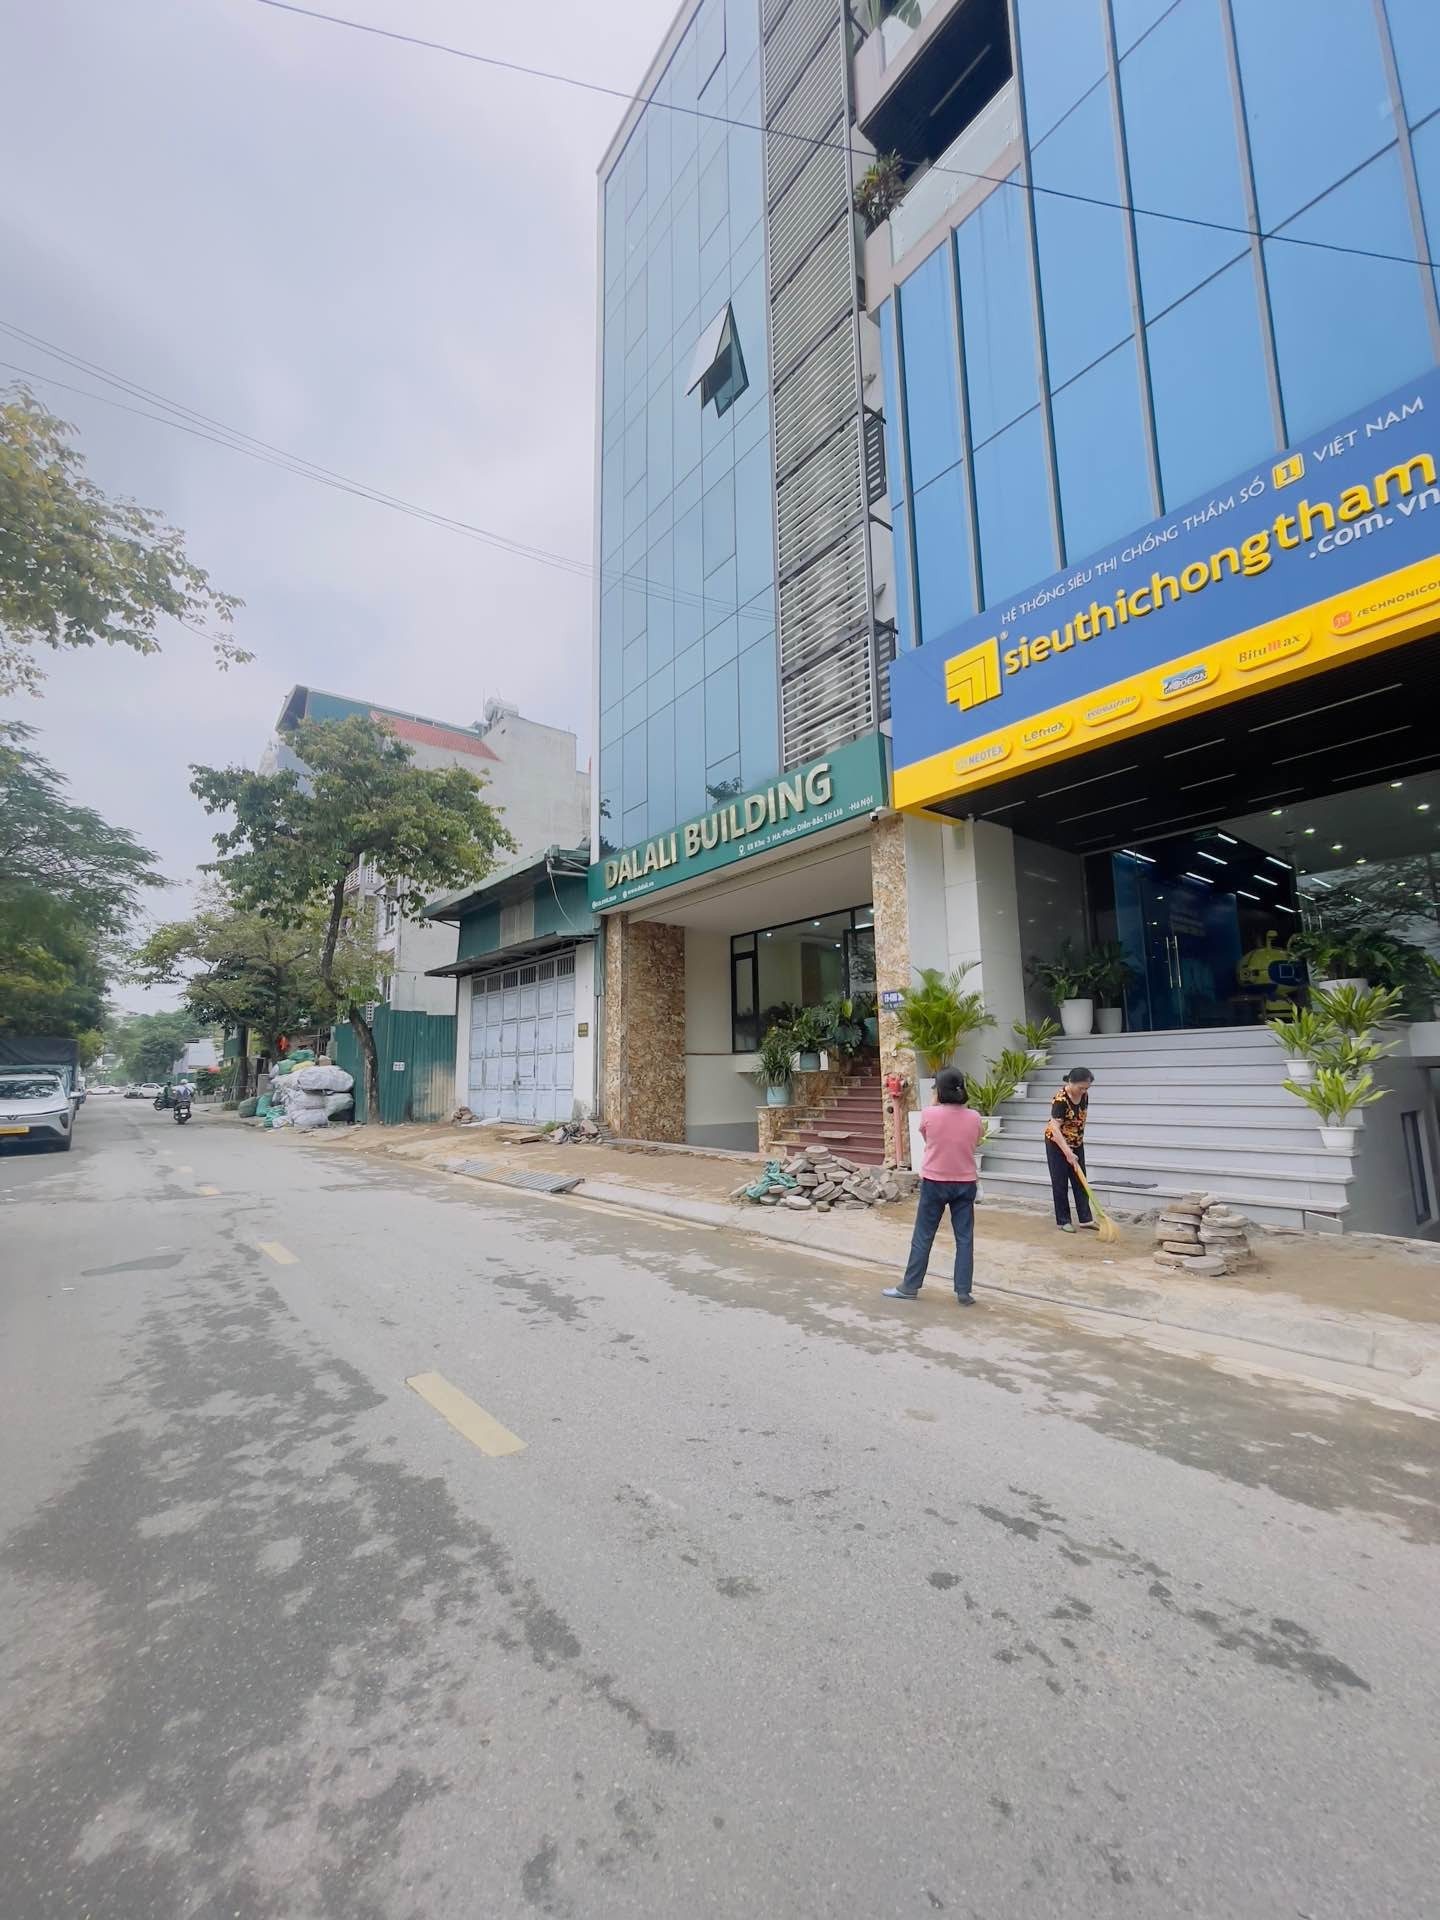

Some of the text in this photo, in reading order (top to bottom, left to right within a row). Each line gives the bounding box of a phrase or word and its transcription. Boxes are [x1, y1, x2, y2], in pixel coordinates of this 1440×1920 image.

[1002, 609, 1017, 624] HỆ
[1019, 583, 1066, 615] THỐNG
[1067, 569, 1092, 592] SIÊU
[1095, 556, 1117, 576] THỊ
[1121, 525, 1179, 563] CHỐNG
[1182, 496, 1236, 532] THẤM
[1240, 475, 1265, 504] SỐ
[1313, 430, 1358, 463] VIỆT
[1366, 396, 1424, 438] NAM
[1004, 453, 1437, 676] sieuthichongtham
[605, 763, 832, 889] DALALI BUILDING
[968, 744, 1004, 766] NEOTEX
